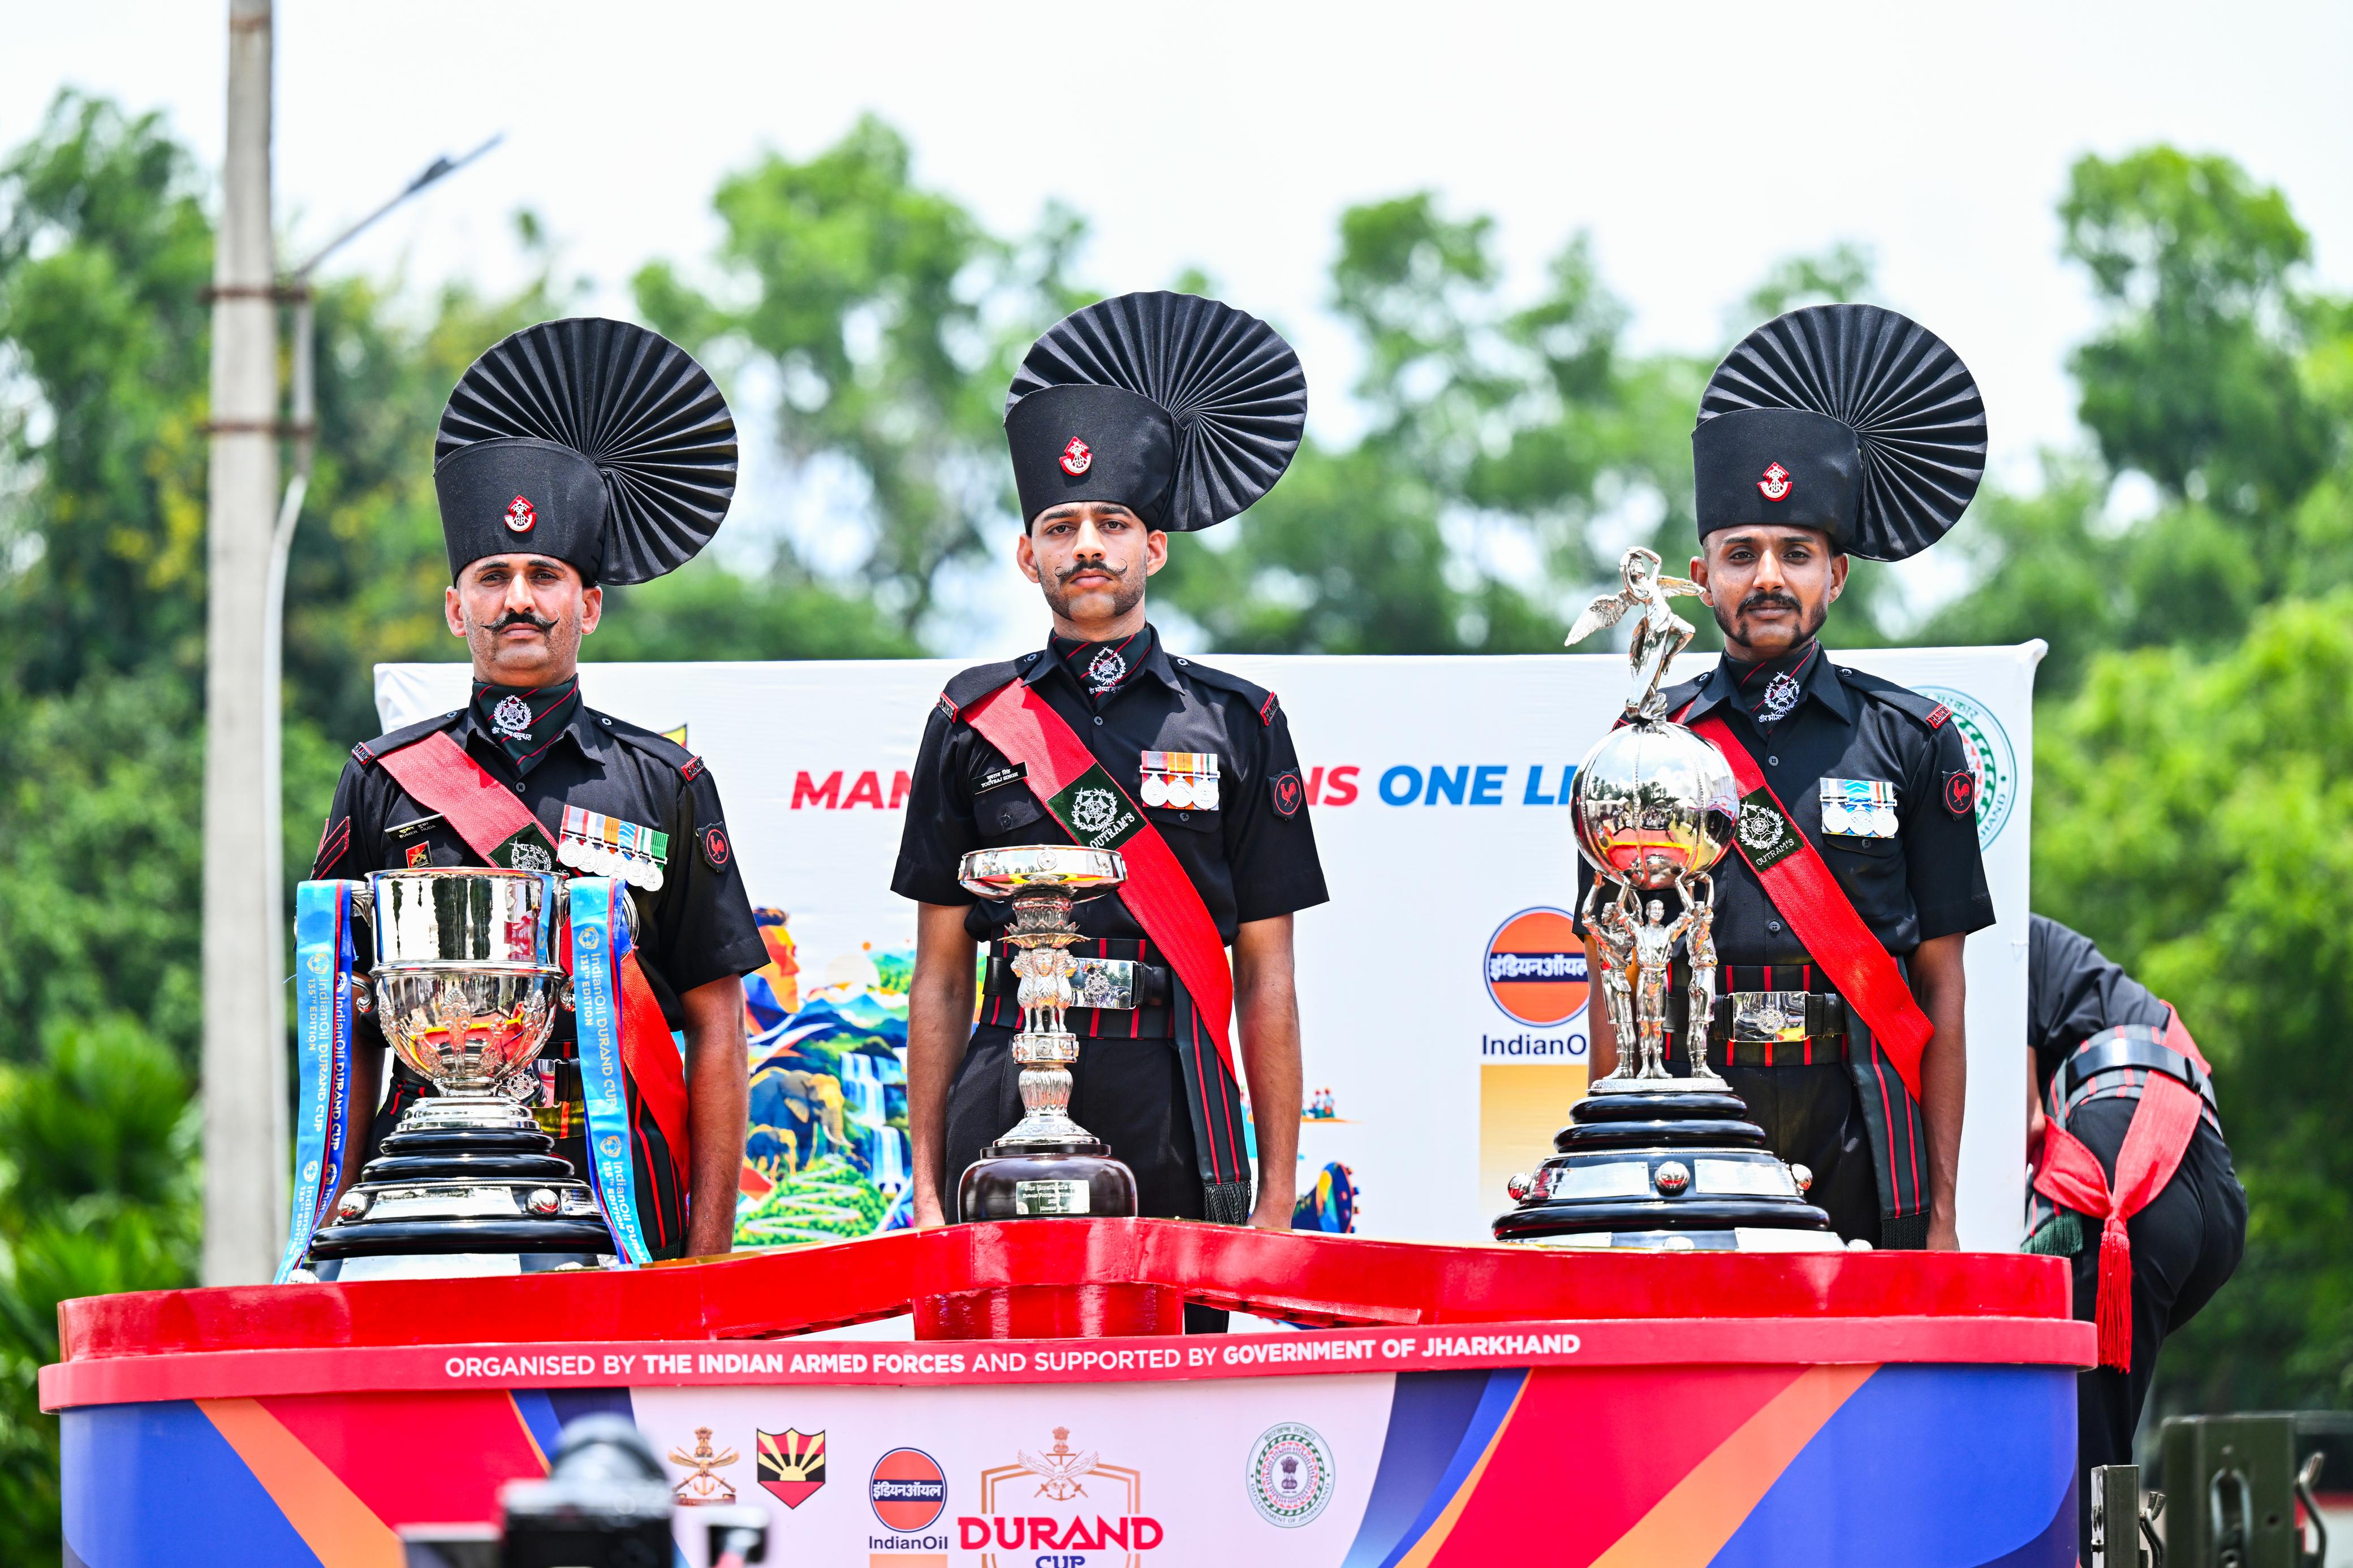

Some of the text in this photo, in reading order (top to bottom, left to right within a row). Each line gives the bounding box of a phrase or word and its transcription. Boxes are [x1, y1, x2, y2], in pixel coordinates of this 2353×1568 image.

[981, 772, 1019, 788] YOUVRAJ SINGH
[1379, 765, 1509, 806] ONE
[1089, 812, 1135, 849] OUTRAM'S
[1756, 838, 1795, 866] OUTRAM'S
[582, 981, 593, 1026] EDITION
[308, 1006, 317, 1051] EDITION
[591, 953, 618, 1107] IndianOil DURAND CUP
[314, 978, 330, 1132] IndianOil DURAND CUP
[330, 996, 346, 1151] IndianOil DURAND CUP
[607, 1188, 625, 1230] EDITION
[614, 1161, 631, 1221] IndianOil
[299, 1185, 315, 1245] IndianOil
[446, 1334, 1580, 1377] ORGANISED BY THE INDIAN ARMED FORCES AND SUPPORTED BY GOVERNMENT OF JHARKHAND
[873, 1481, 942, 1500] इंडियनऑयल
[1251, 1483, 1286, 1523] GOVERNMENT
[1298, 1483, 1330, 1522] JHARKHAND
[869, 1536, 948, 1549] IndianOil
[958, 1514, 1163, 1552] DURAND
[1036, 1556, 1085, 1568] CUP
